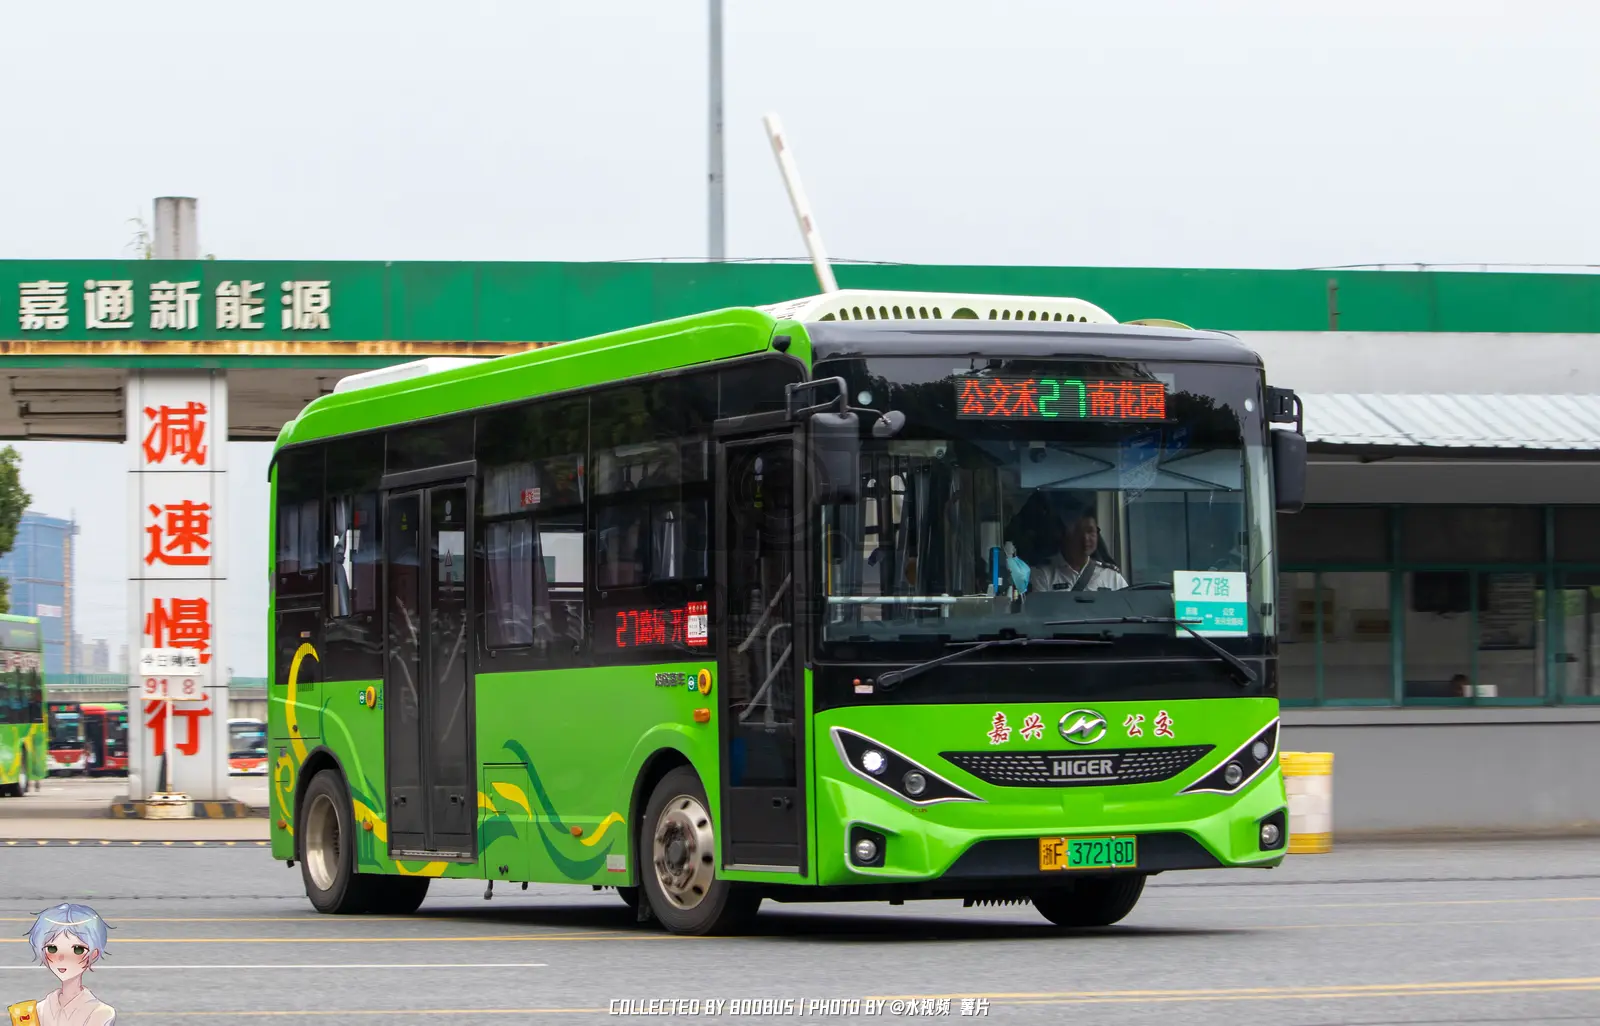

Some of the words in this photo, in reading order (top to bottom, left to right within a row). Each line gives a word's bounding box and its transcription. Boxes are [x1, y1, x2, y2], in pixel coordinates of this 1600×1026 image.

[18, 280, 332, 330] 嘉通新能源
[1191, 577, 1230, 597] 27路
[987, 712, 1045, 745] 嘉兴
[1122, 709, 1175, 739] 公交
[1053, 760, 1114, 777] HIGER
